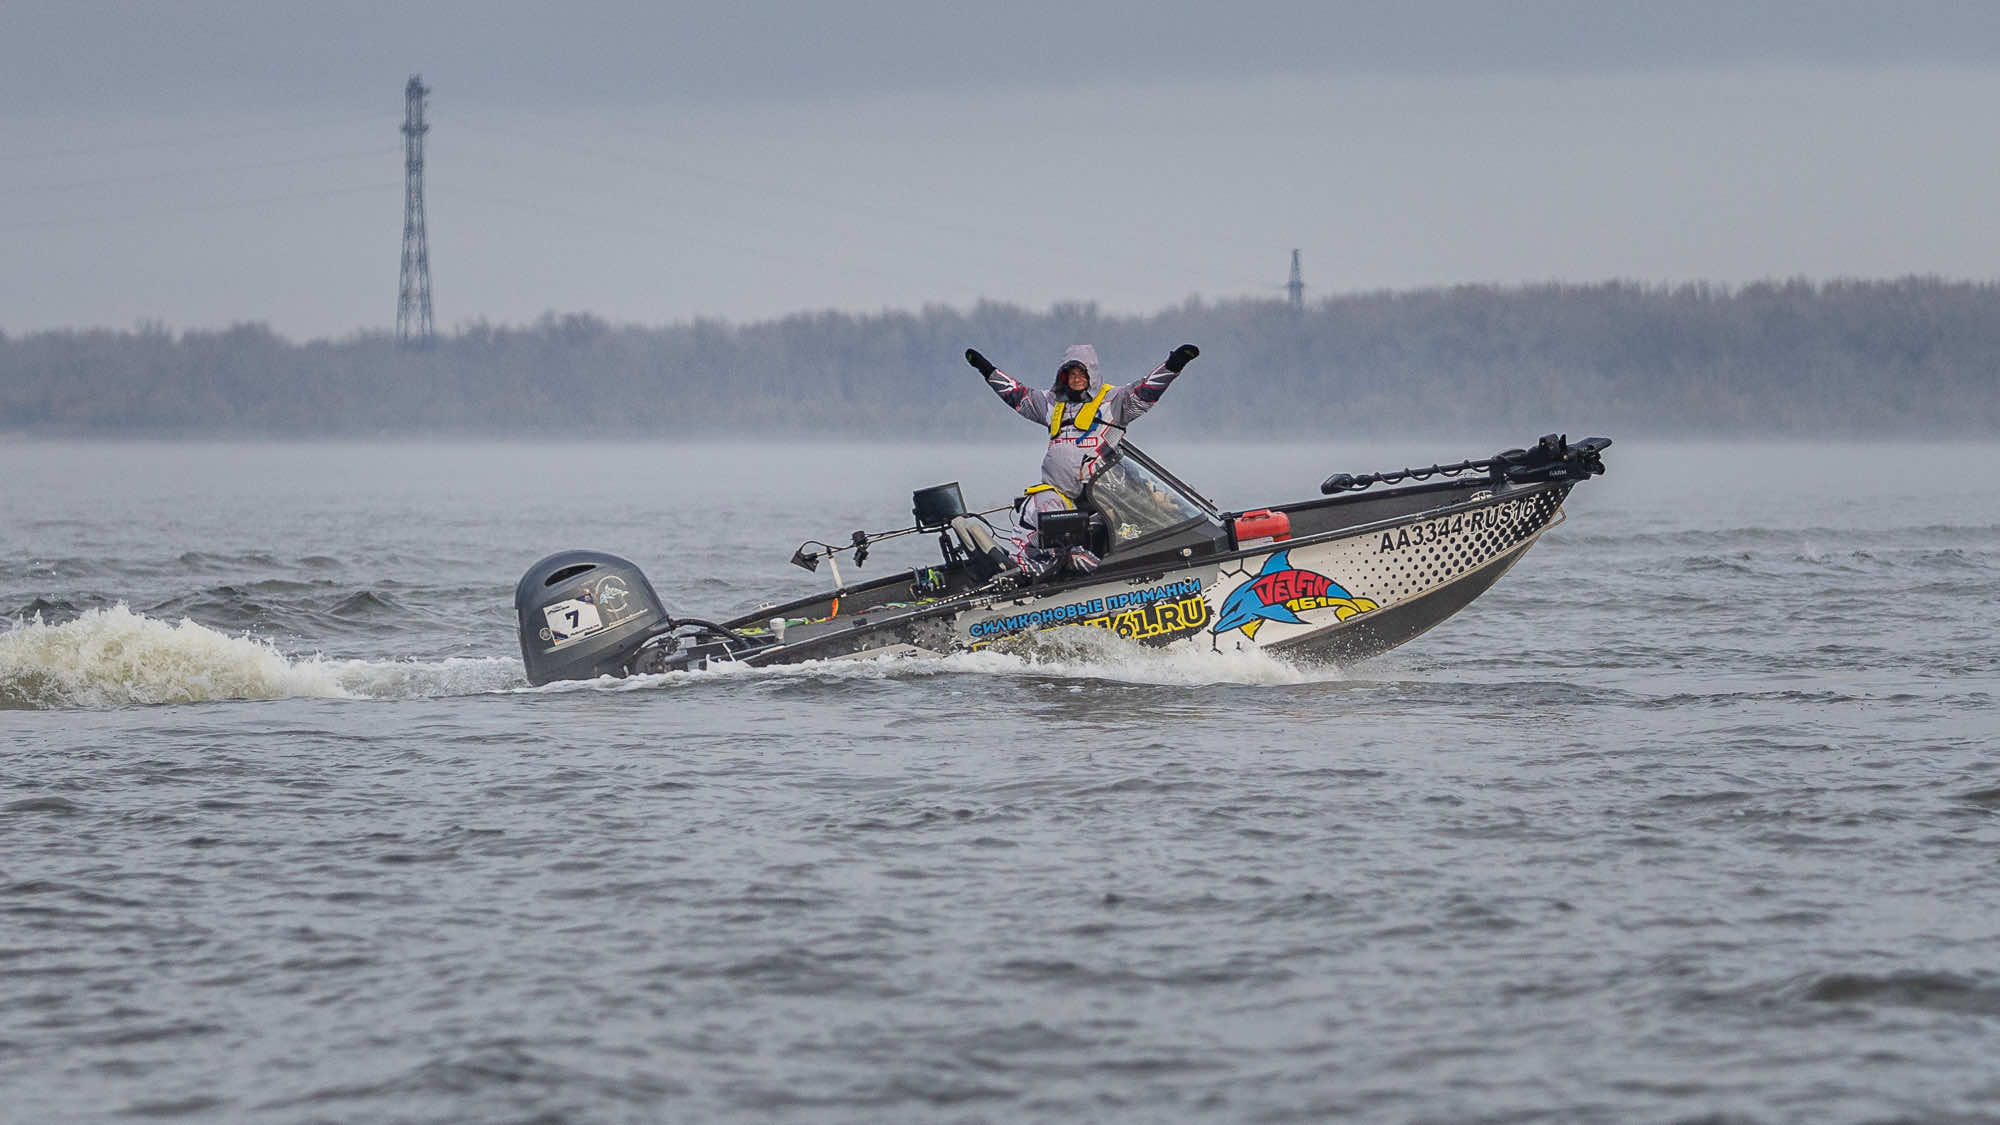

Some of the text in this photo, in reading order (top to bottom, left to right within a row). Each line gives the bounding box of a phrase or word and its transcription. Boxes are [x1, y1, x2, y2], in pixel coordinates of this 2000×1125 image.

[969, 578, 1202, 638] СИЛИКОНОВЫЕ ПРИМАНКИ
[1286, 597, 1327, 612] 161
[564, 609, 579, 629] 7
